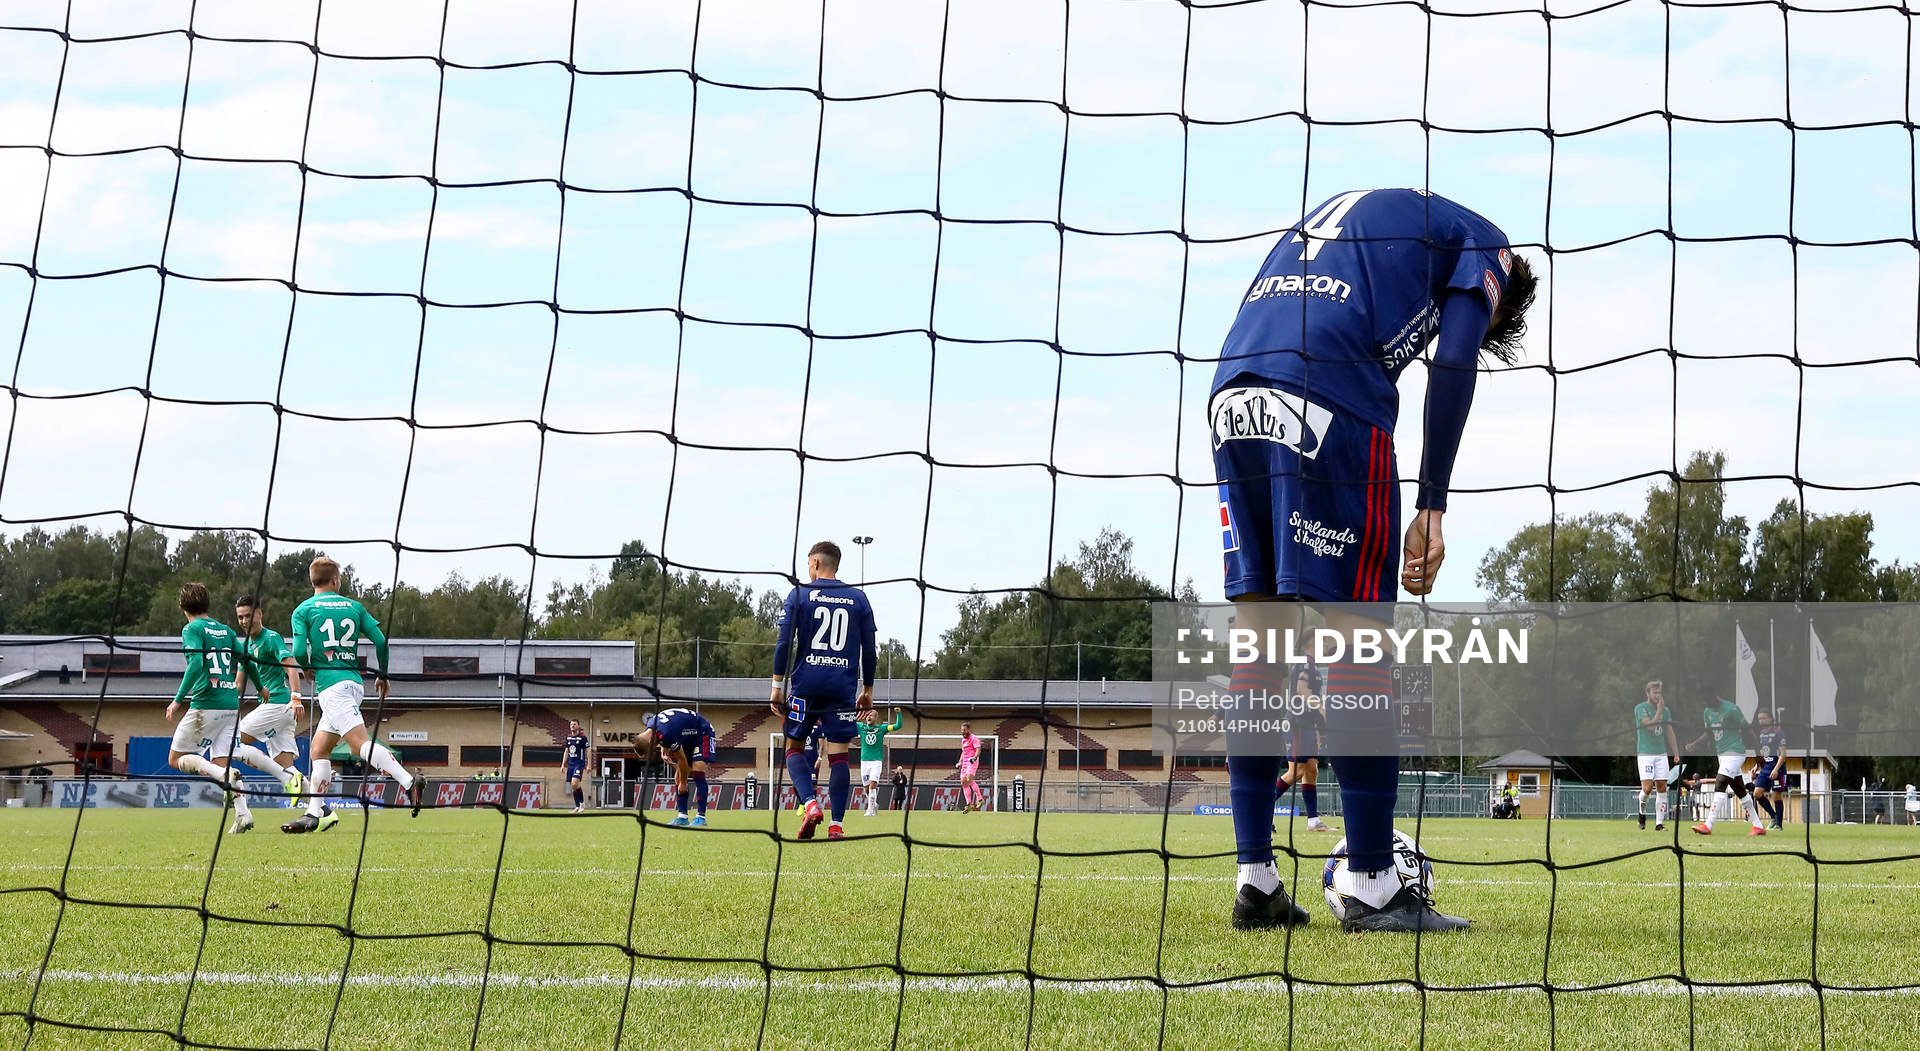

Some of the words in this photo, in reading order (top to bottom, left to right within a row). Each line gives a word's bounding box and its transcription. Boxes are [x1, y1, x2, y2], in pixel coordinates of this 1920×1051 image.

[1290, 190, 1374, 262] 4
[1246, 273, 1352, 303] ynacon
[1262, 292, 1346, 304] CONSTRCTION
[319, 617, 356, 648] 12
[810, 606, 850, 652] 20
[205, 646, 233, 675] 19
[805, 653, 849, 667] dynacon
[197, 737, 213, 749] JP
[602, 732, 640, 743] VAPE
[746, 781, 755, 808] SELECT
[1015, 785, 1024, 810] SELECT
